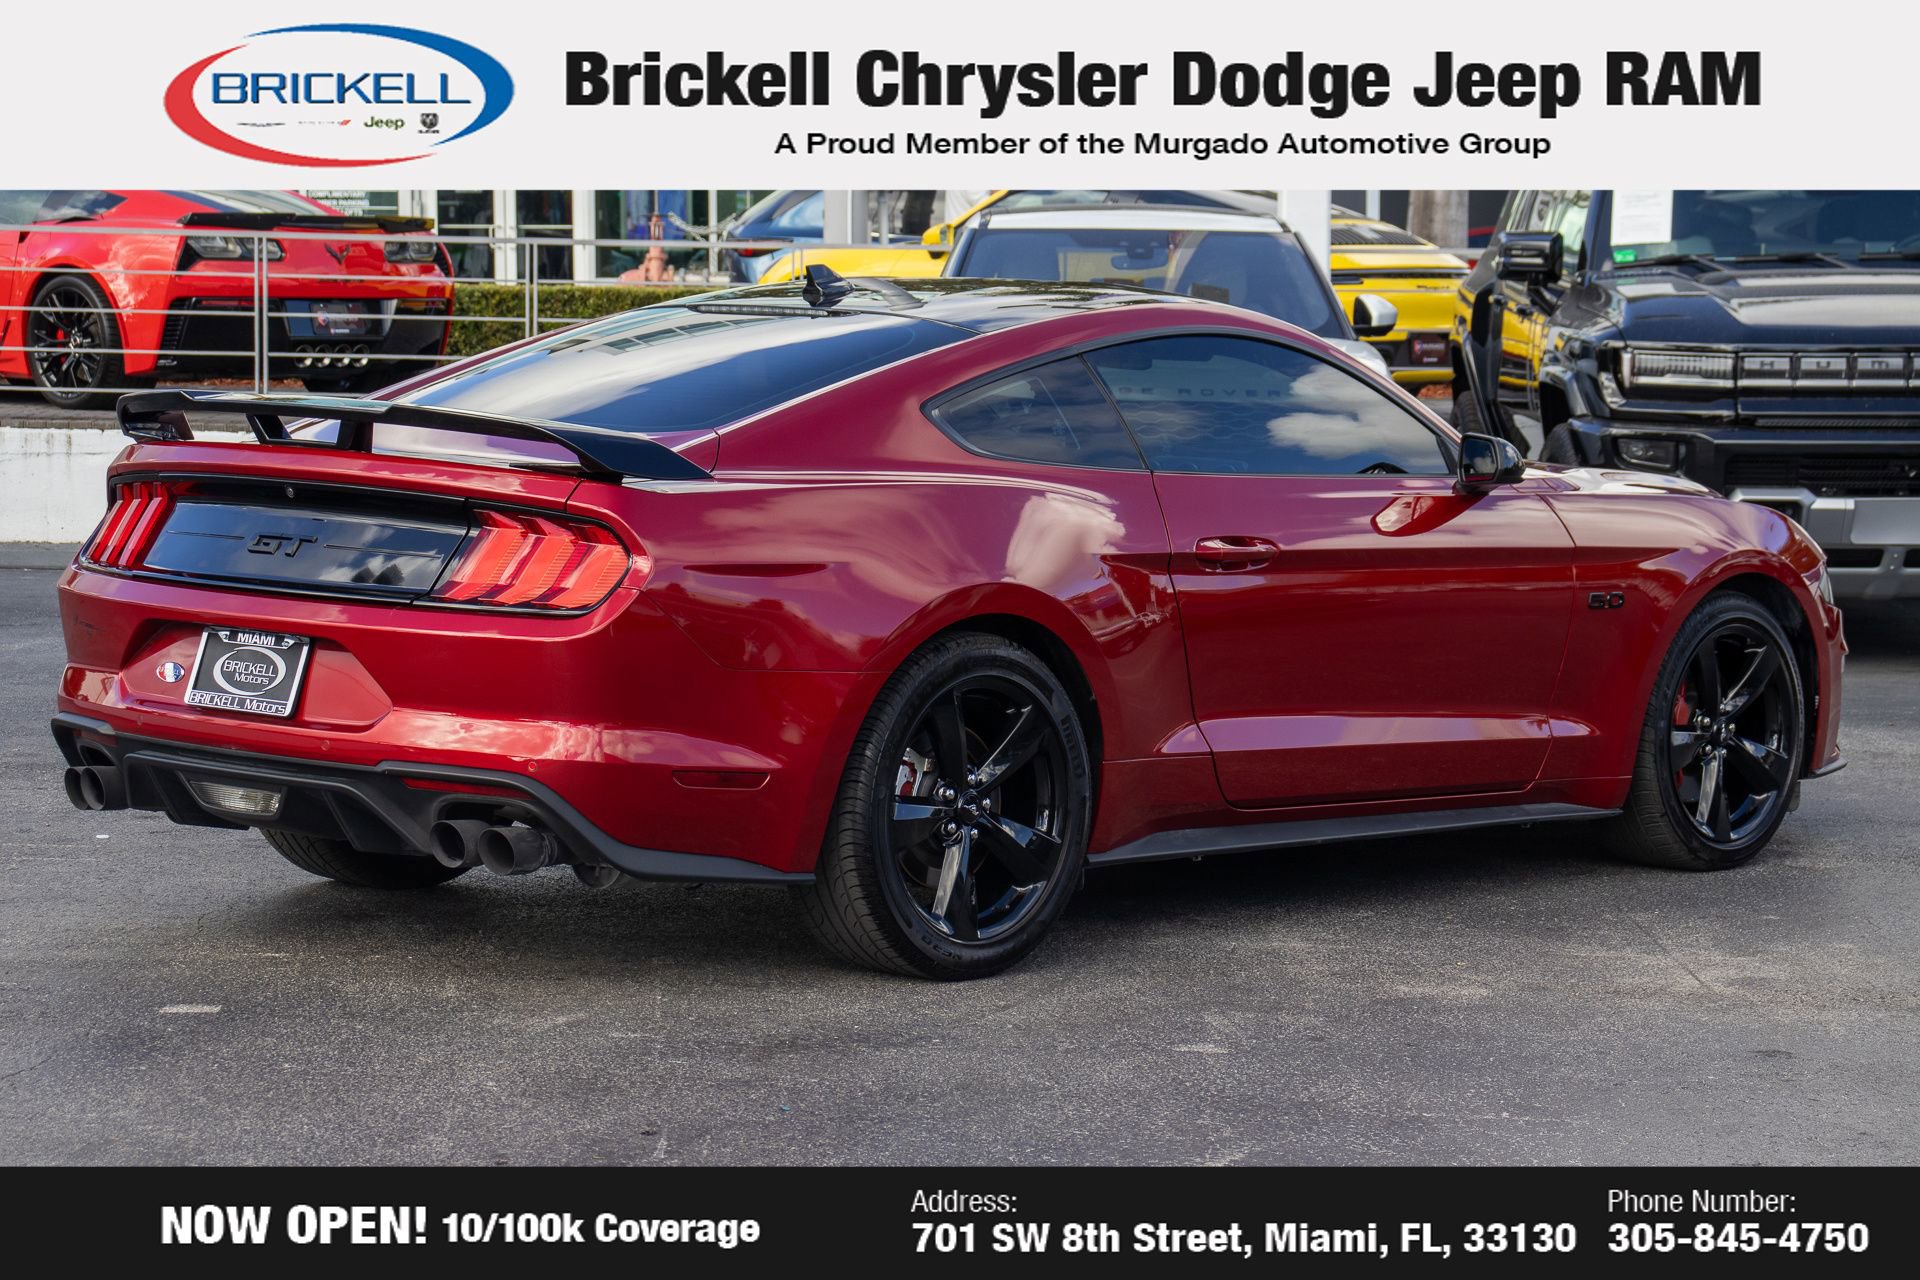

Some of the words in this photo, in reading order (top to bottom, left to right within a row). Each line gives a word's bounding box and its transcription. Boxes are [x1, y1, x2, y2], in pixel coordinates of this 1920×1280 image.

[1177, 388, 1281, 398] ROVER
[247, 534, 318, 558] GT
[237, 632, 276, 647] MIAMI
[223, 659, 277, 677] BRICKELL
[234, 673, 270, 685] Motors
[189, 691, 241, 709] BRICKELL
[244, 699, 287, 715] Motors
